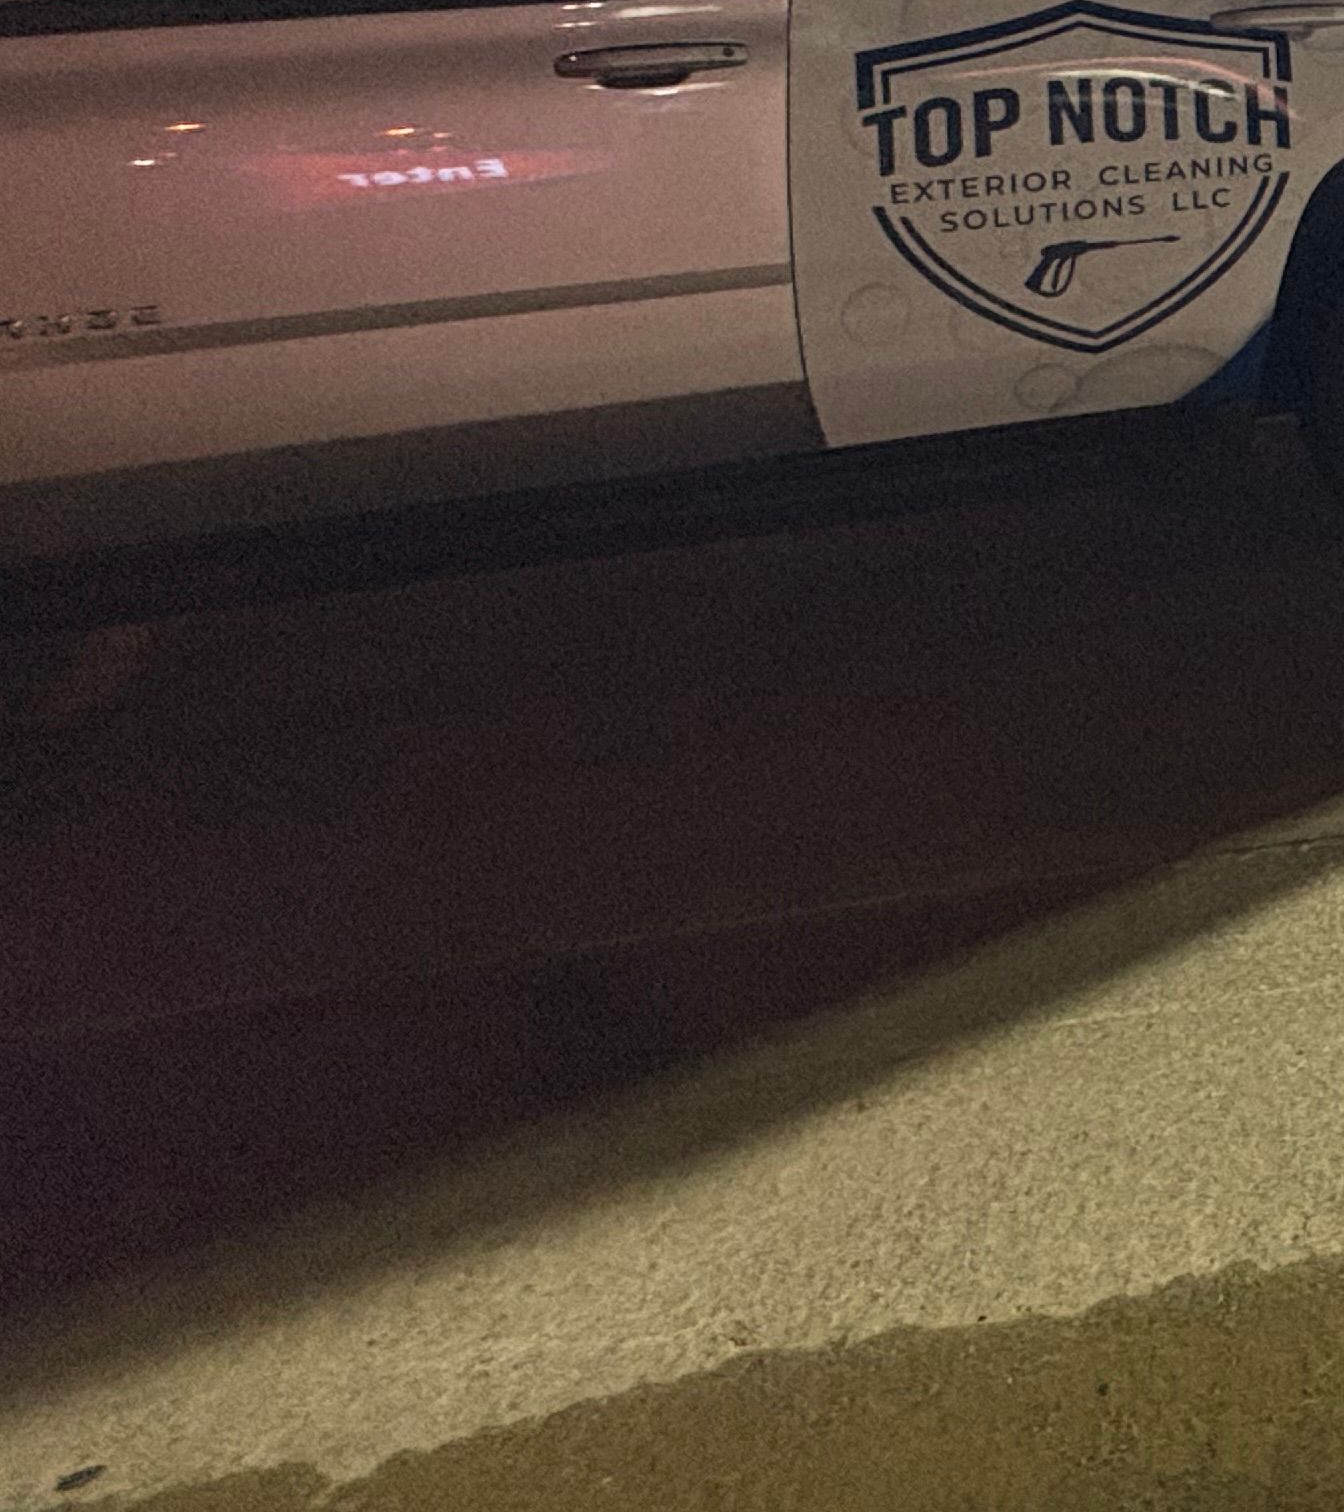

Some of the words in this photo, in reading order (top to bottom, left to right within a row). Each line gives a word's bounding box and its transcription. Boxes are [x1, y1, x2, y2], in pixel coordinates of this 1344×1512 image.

[862, 87, 1020, 177] TOP
[1047, 76, 1292, 149] NOTCH
[890, 170, 1071, 204] EXTERIOR
[1098, 153, 1274, 186] CLEANING
[940, 194, 1146, 233] SOLUTIONS
[1172, 188, 1232, 212] LLC
